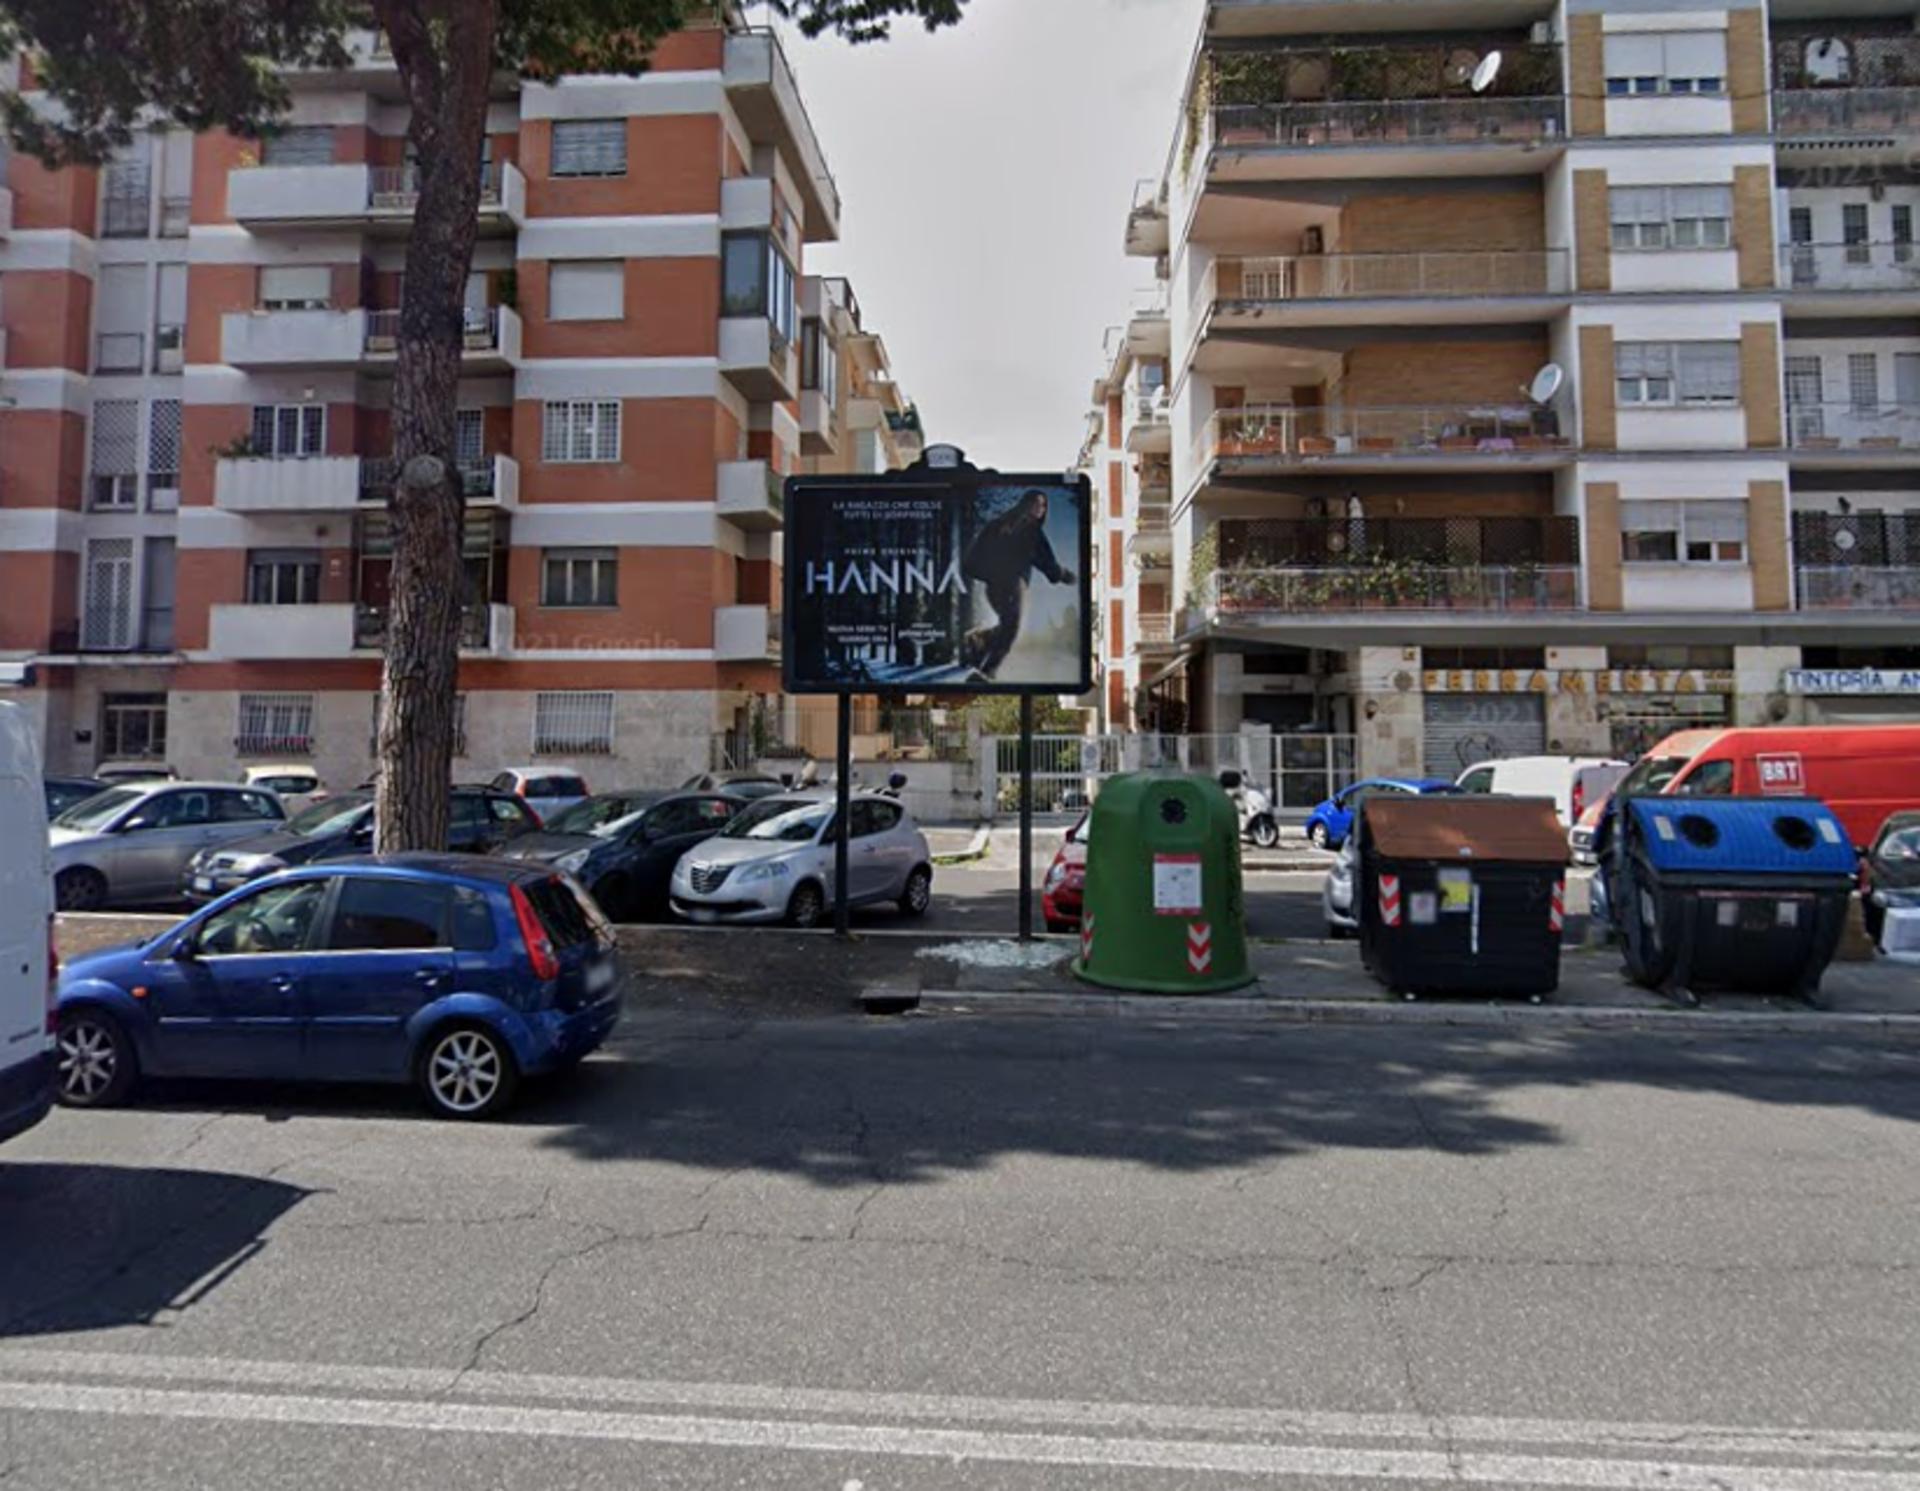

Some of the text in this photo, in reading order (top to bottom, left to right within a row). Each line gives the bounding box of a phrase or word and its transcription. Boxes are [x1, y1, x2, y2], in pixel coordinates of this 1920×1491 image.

[805, 560, 967, 595] HANNA
[1422, 669, 1697, 693] FERRAMENTA
[1788, 670, 1884, 688] TINTORIA
[1762, 761, 1799, 781] BRT
